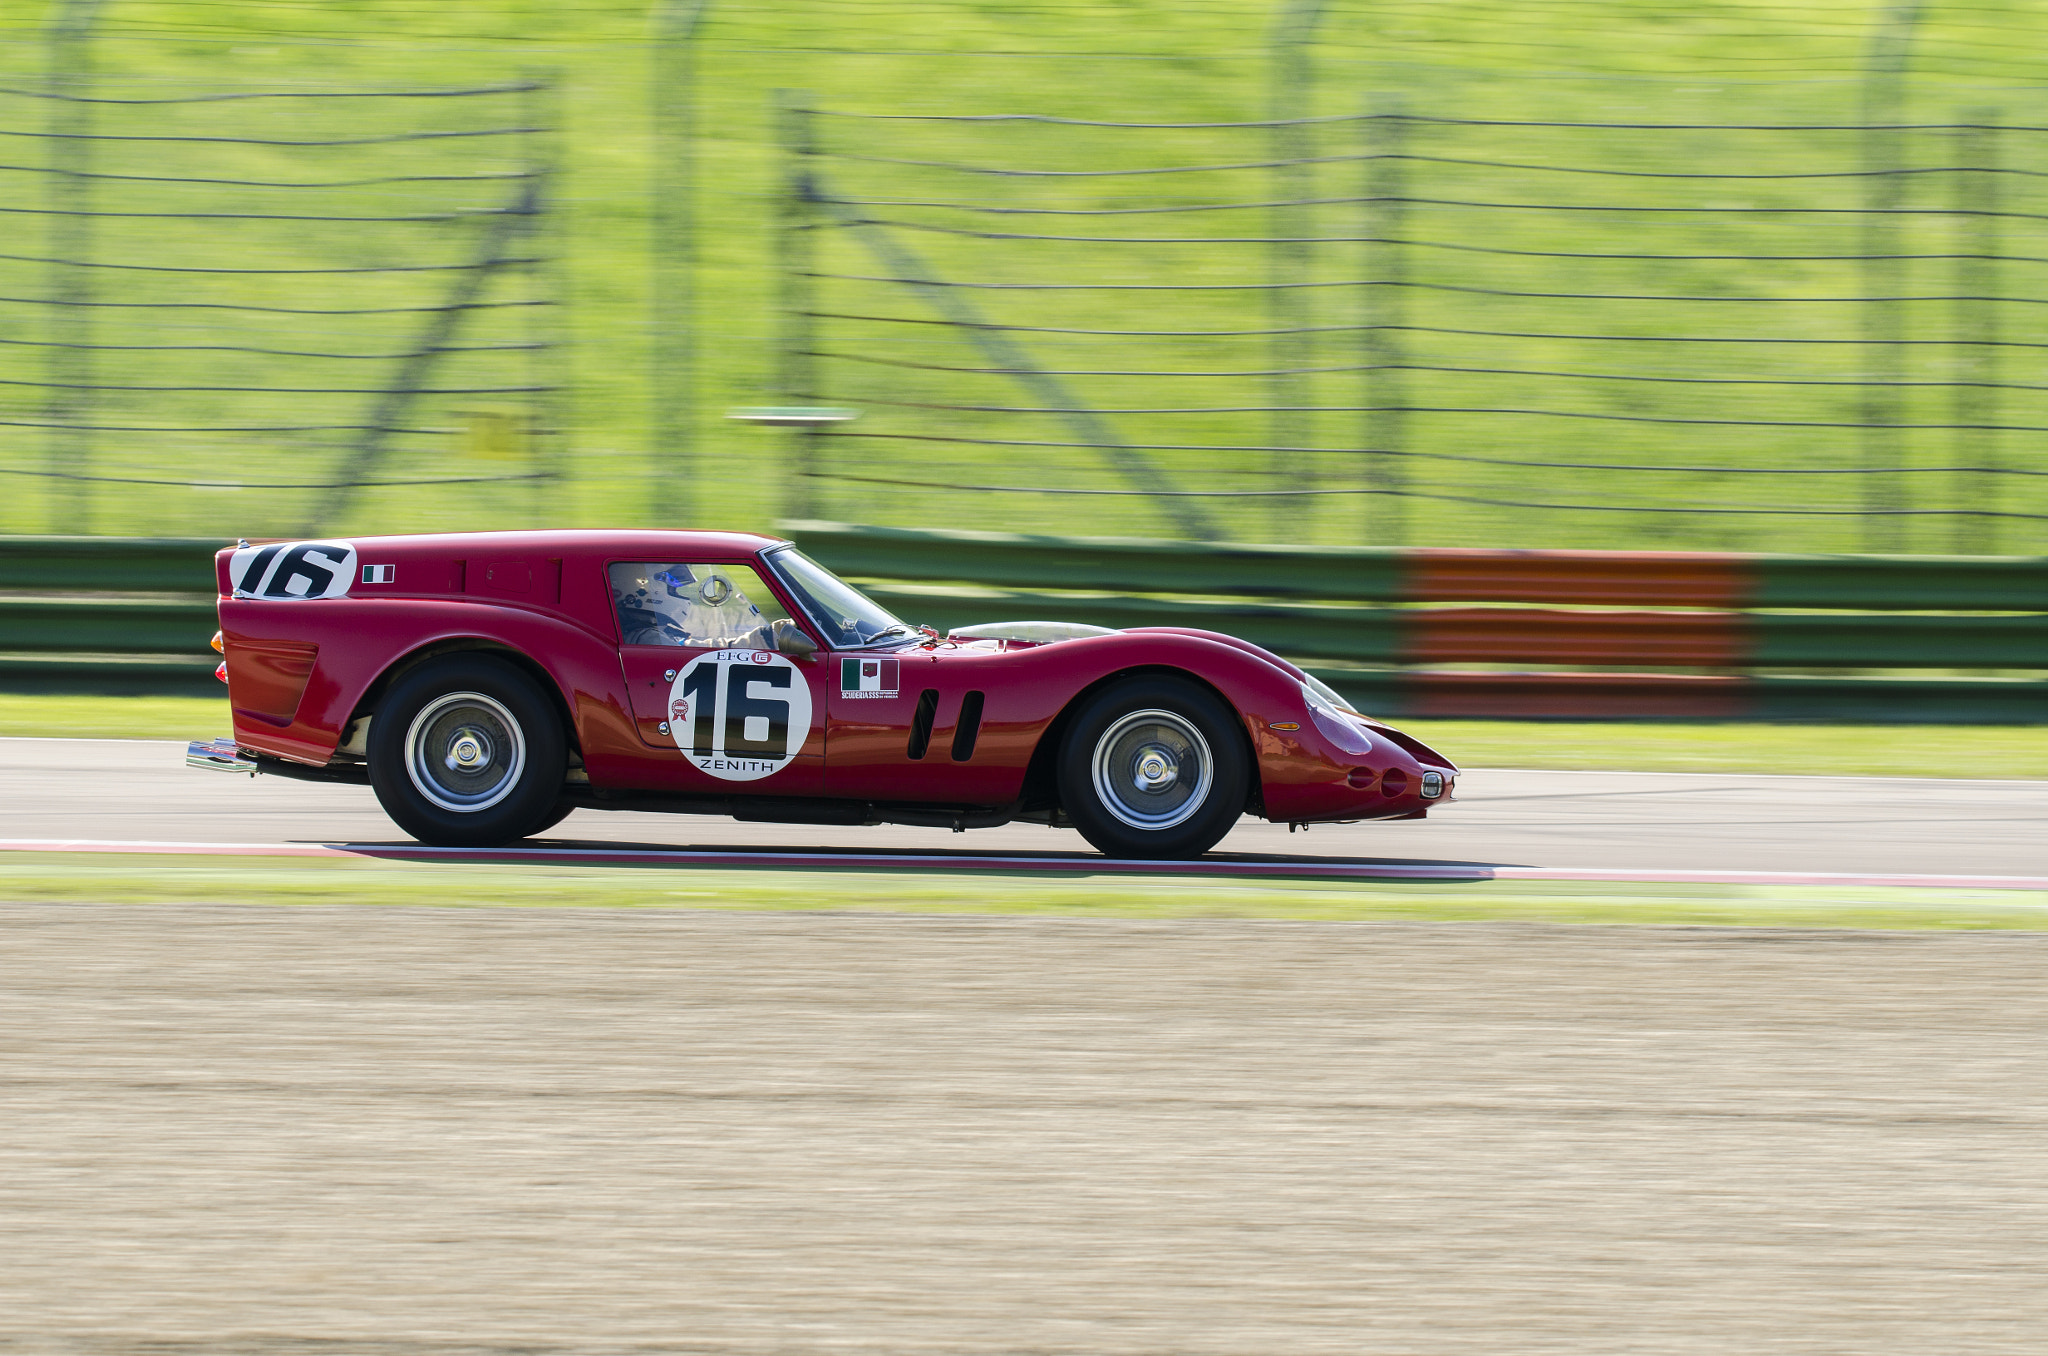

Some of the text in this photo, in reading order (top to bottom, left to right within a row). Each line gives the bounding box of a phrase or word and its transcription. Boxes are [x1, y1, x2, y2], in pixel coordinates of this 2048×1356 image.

[240, 544, 350, 598] 16
[715, 651, 750, 661] EFG
[683, 662, 791, 760] 16
[700, 759, 774, 772] ZENITH
